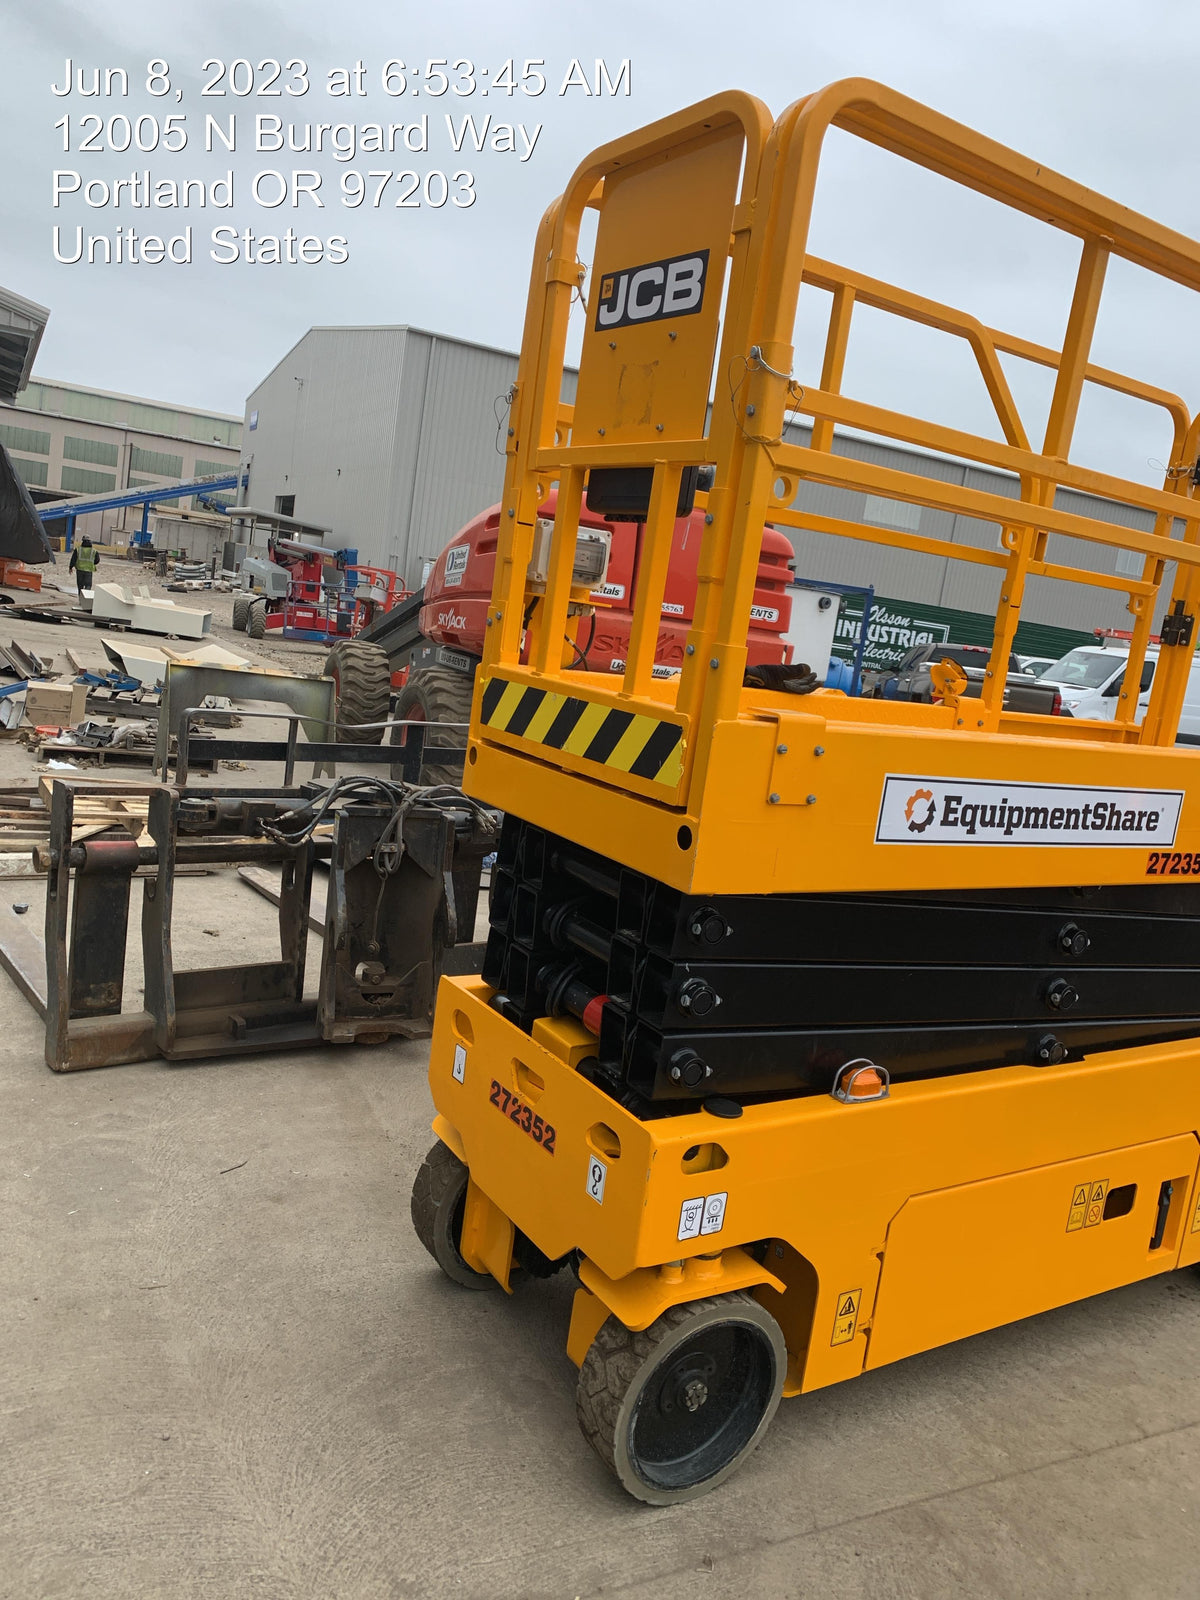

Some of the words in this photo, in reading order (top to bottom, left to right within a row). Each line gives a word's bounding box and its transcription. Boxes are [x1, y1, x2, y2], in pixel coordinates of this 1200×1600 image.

[599, 257, 704, 325] JCB
[940, 795, 1160, 836] EquipmentShare
[490, 1080, 556, 1154] 272352
